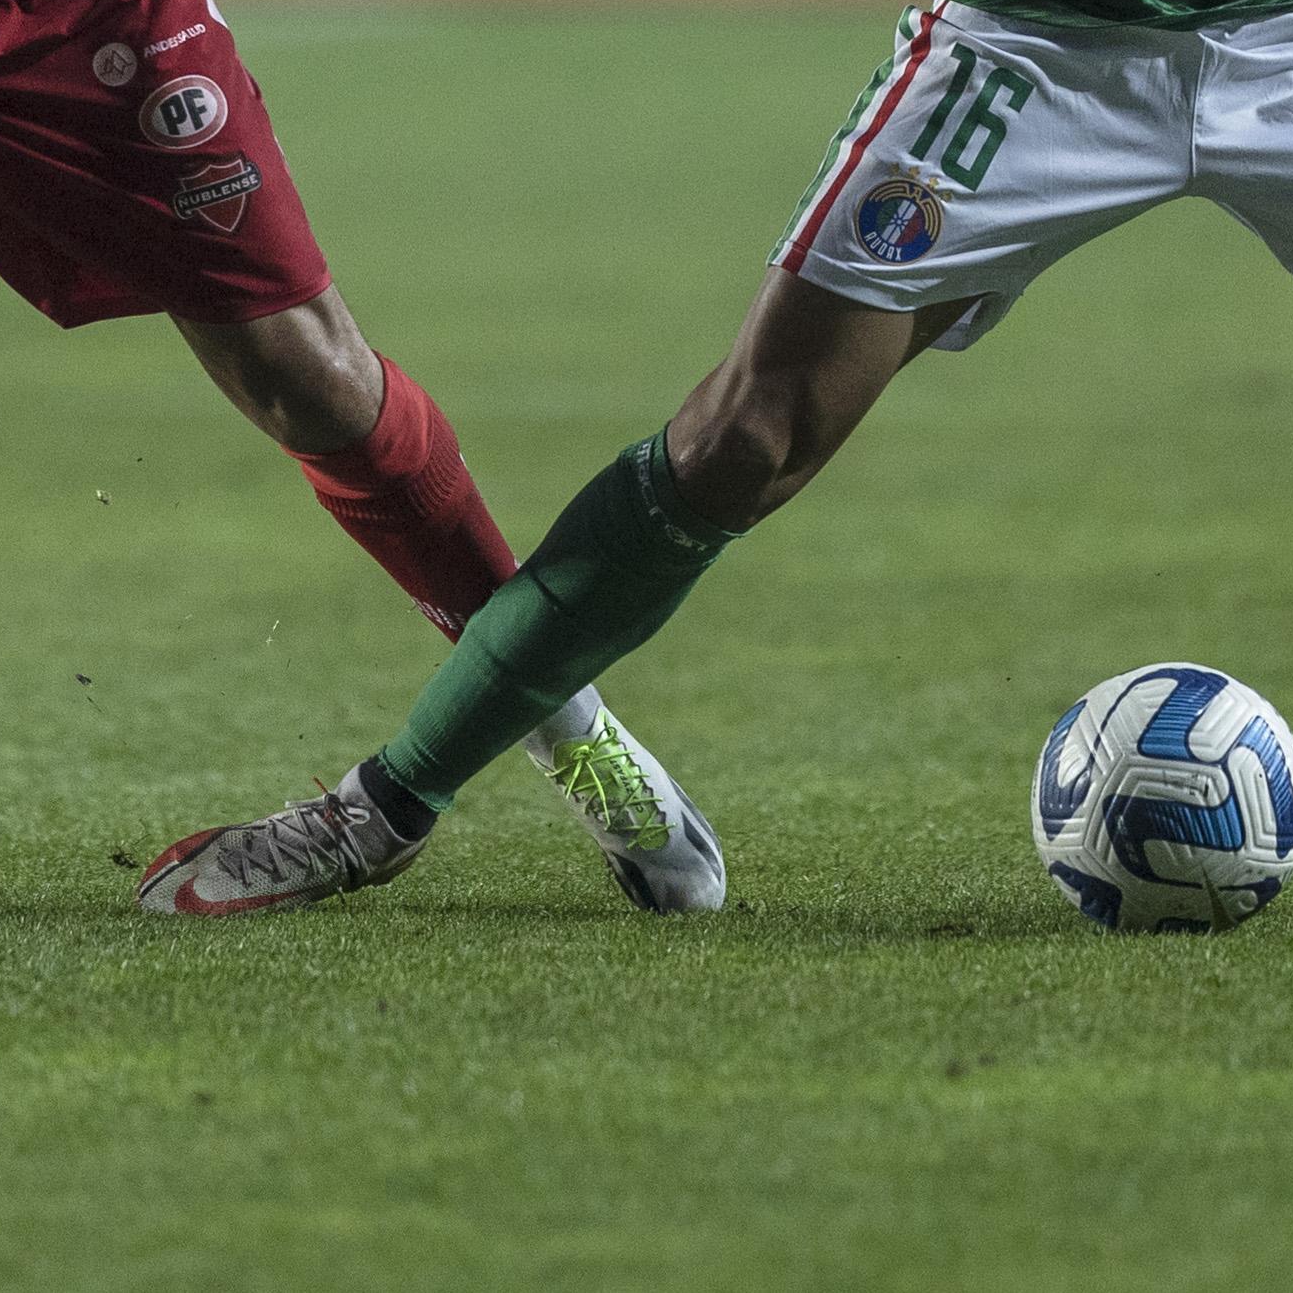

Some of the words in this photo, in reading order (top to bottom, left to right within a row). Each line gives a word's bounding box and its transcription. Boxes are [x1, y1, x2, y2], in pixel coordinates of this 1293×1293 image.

[158, 88, 208, 135] PF
[908, 42, 1036, 193] 16
[863, 230, 902, 261] AUDAX
